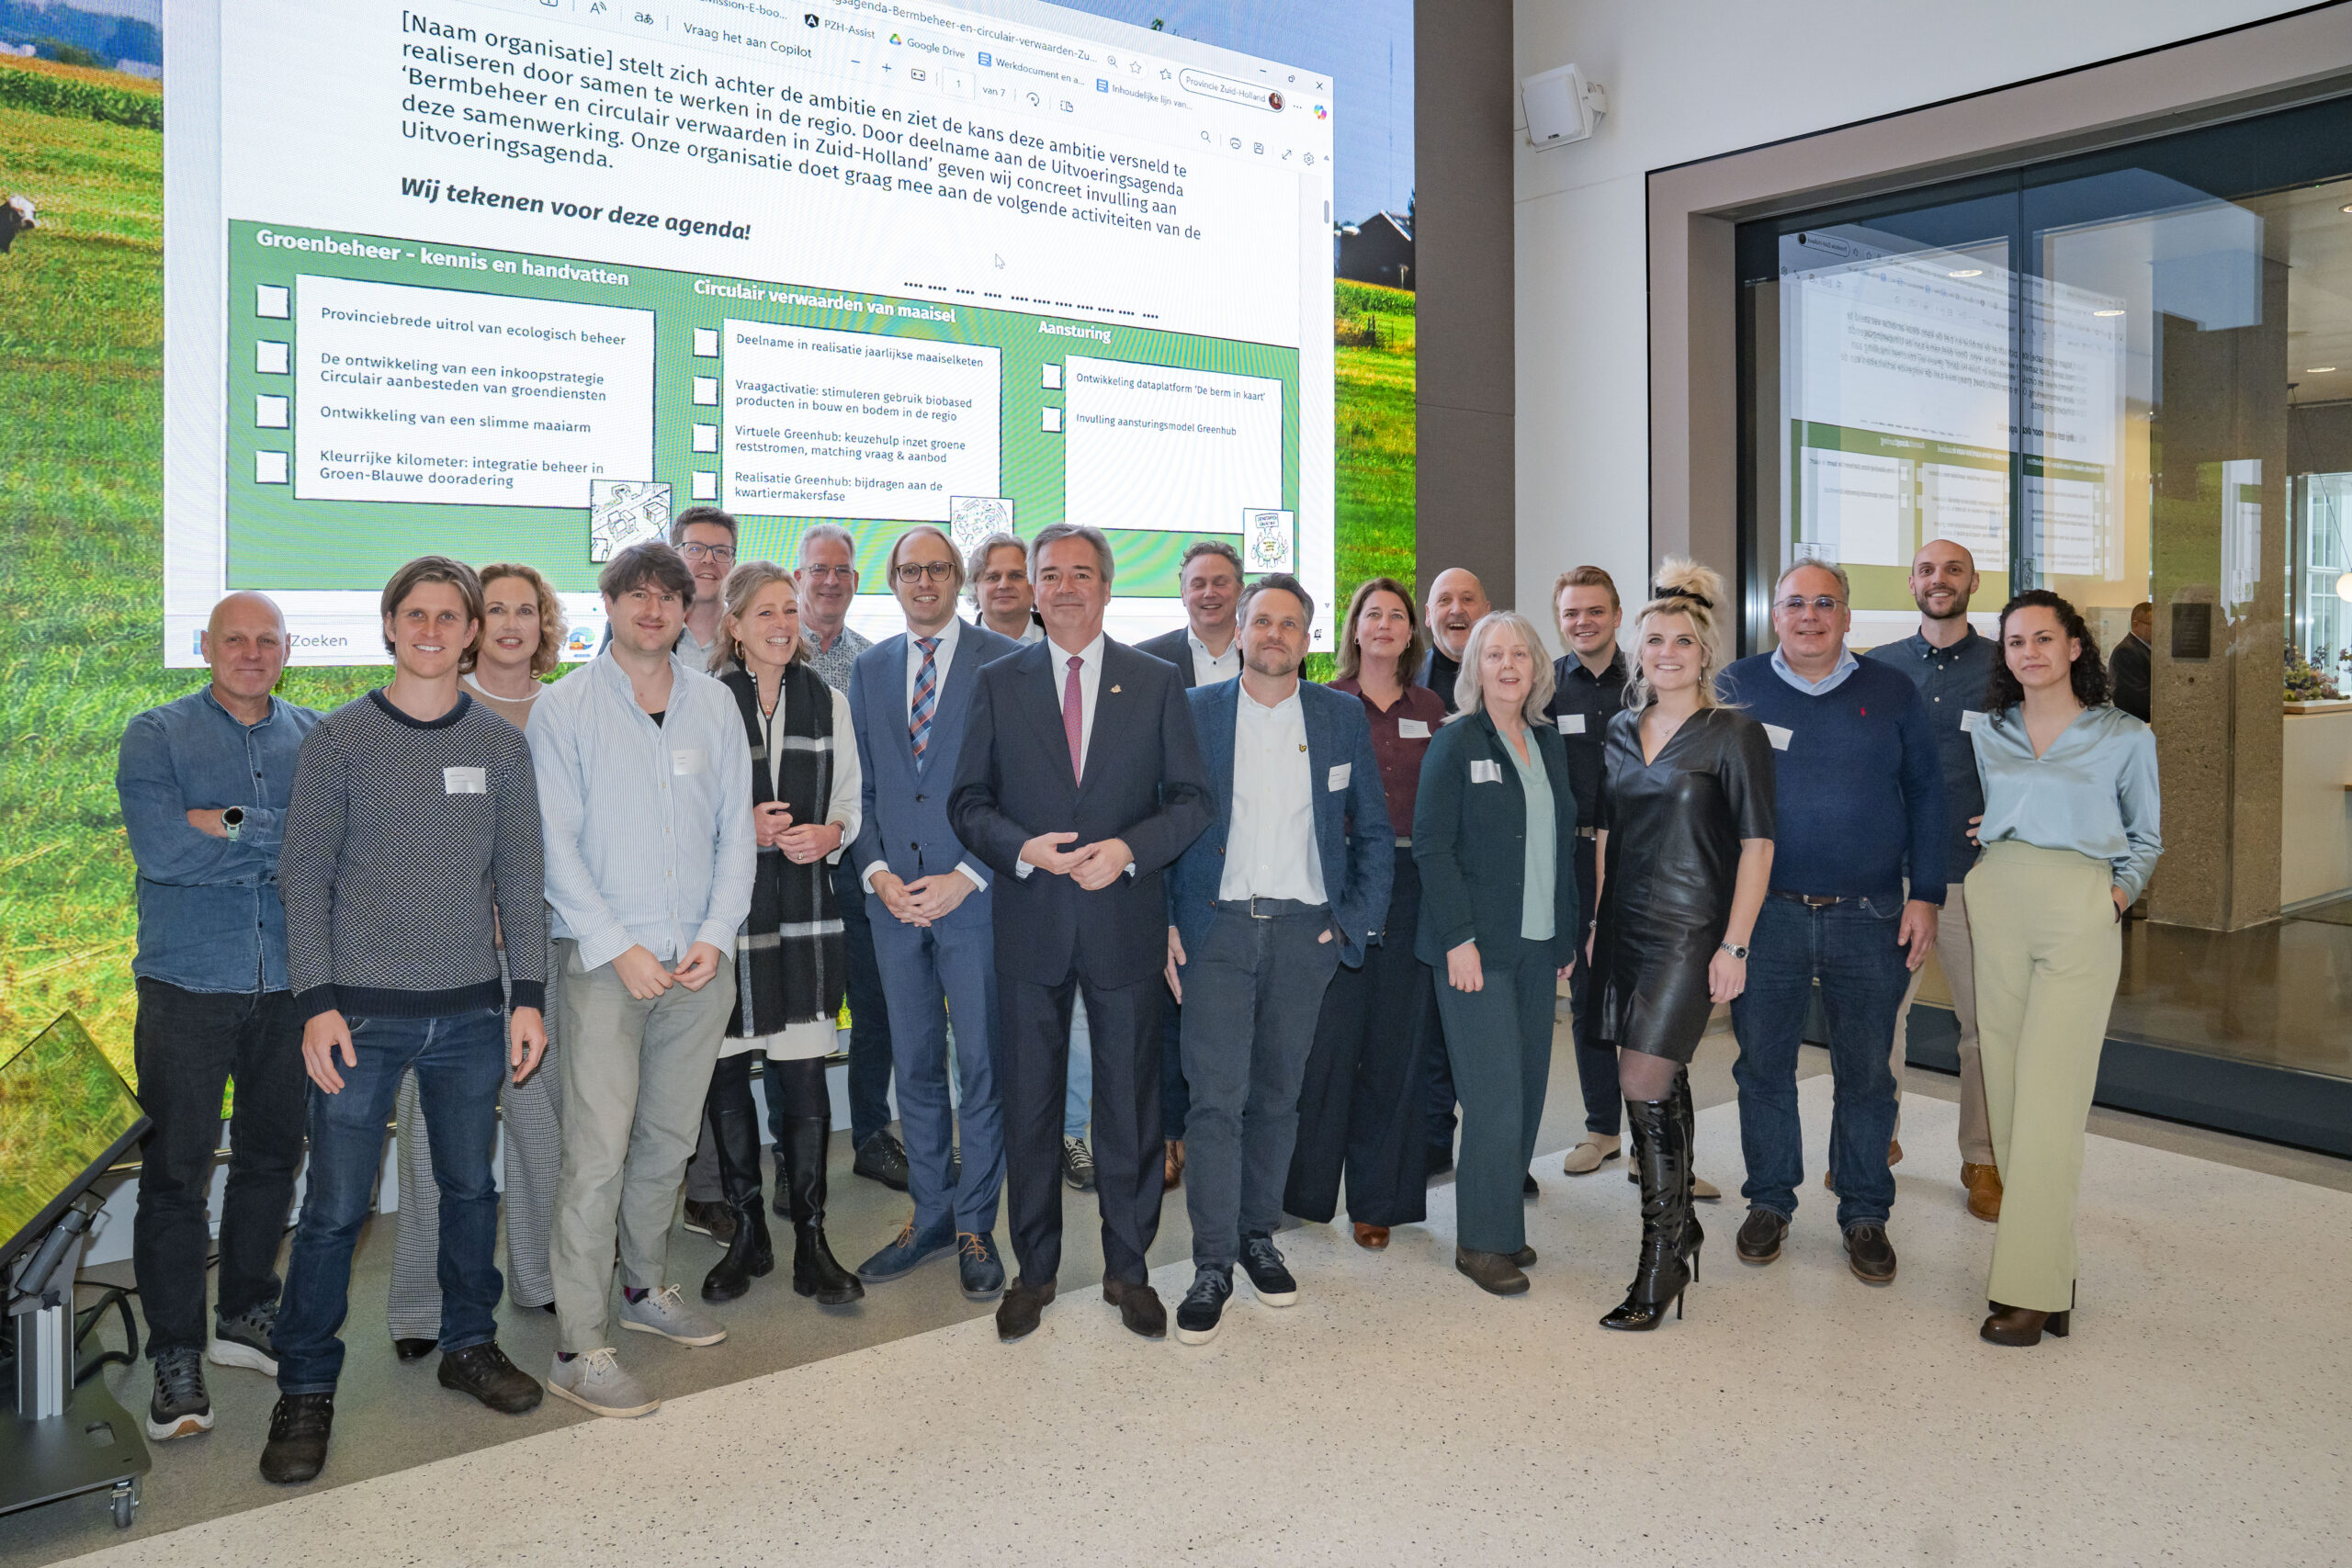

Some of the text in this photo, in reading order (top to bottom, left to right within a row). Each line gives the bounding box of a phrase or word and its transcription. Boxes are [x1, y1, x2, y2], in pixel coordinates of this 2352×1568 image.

[684, 22, 811, 58] Vraag het aan Copilot
[824, 19, 875, 39] PZH-Assist
[907, 38, 965, 58] Google Drive
[995, 57, 1058, 79] Werkdocument
[402, 11, 1186, 177] [Naam organisatie] stelt zich achter de ambitie en ziet de kans deze ambitie versneld te
[1113, 85, 1159, 103] Inhoudelijke
[1161, 96, 1171, 106] lijn
[1186, 76, 1266, 103] Provincie Zuid-Holland
[403, 43, 1183, 197] realiseren door samen te werken in de regio. Door deelname aan de Uitvoeringsagenda
[402, 119, 613, 168] Uitvoeringsagenda.
[554, 96, 579, 112] en
[587, 99, 670, 127] circulair
[675, 117, 786, 147] verwaarden
[794, 133, 808, 151] in
[937, 163, 984, 181] geven
[989, 169, 1011, 189] wij
[1017, 177, 1081, 198] concreet
[1087, 185, 1148, 213] invulling
[1152, 201, 1176, 215] aan
[401, 94, 1201, 240] deze samenwerking. Onze organisatie doet graag mee aan de volgende activiteiten van de
[401, 176, 751, 241] Wij tekenen voor deze agenda!
[256, 230, 629, 286] Groenbeheer kennis en handvatten
[694, 278, 956, 322] Circulair verwaarden van maaisel
[322, 307, 626, 344] Provinciebrede uitrol van ecologisch beheer
[1038, 321, 1112, 344] Aansturing
[737, 333, 983, 367] Deelname in realisatie jaarlijkse maaiselketen
[321, 352, 604, 387] De ontwikkeling van een inkoopstrategie
[320, 369, 605, 400] Circulair aanbesteden van groendiensten
[735, 379, 972, 408] Vraagactivatie: stimuleren gebruik biobased
[1076, 372, 1134, 389] Ontwikkeling
[1136, 378, 1192, 393] dataplatform
[1210, 387, 1231, 397] berm
[1233, 389, 1240, 398] in
[320, 406, 591, 433] Ontwikkeling van een slimme maaiarm
[736, 396, 957, 423] producten in bouw en bodem in de regio
[735, 424, 966, 450] Virtuele Greenhub: keuzehulp inzet groene
[1076, 413, 1237, 435] Invulling aansturingsmodel Greenhub
[321, 449, 604, 473] Kleurrijke kilometer: integratie beheer in
[735, 443, 946, 463] reststromen, matching vraag & aanbod
[320, 467, 514, 489] Groen-Blauwe dooradering
[735, 471, 791, 484] Realisatie
[794, 474, 851, 486] Greenhub:
[854, 477, 904, 491] bijdragen
[930, 480, 943, 491] de
[735, 486, 845, 502] kwartiermakersfase
[291, 635, 347, 647] Zoeken
